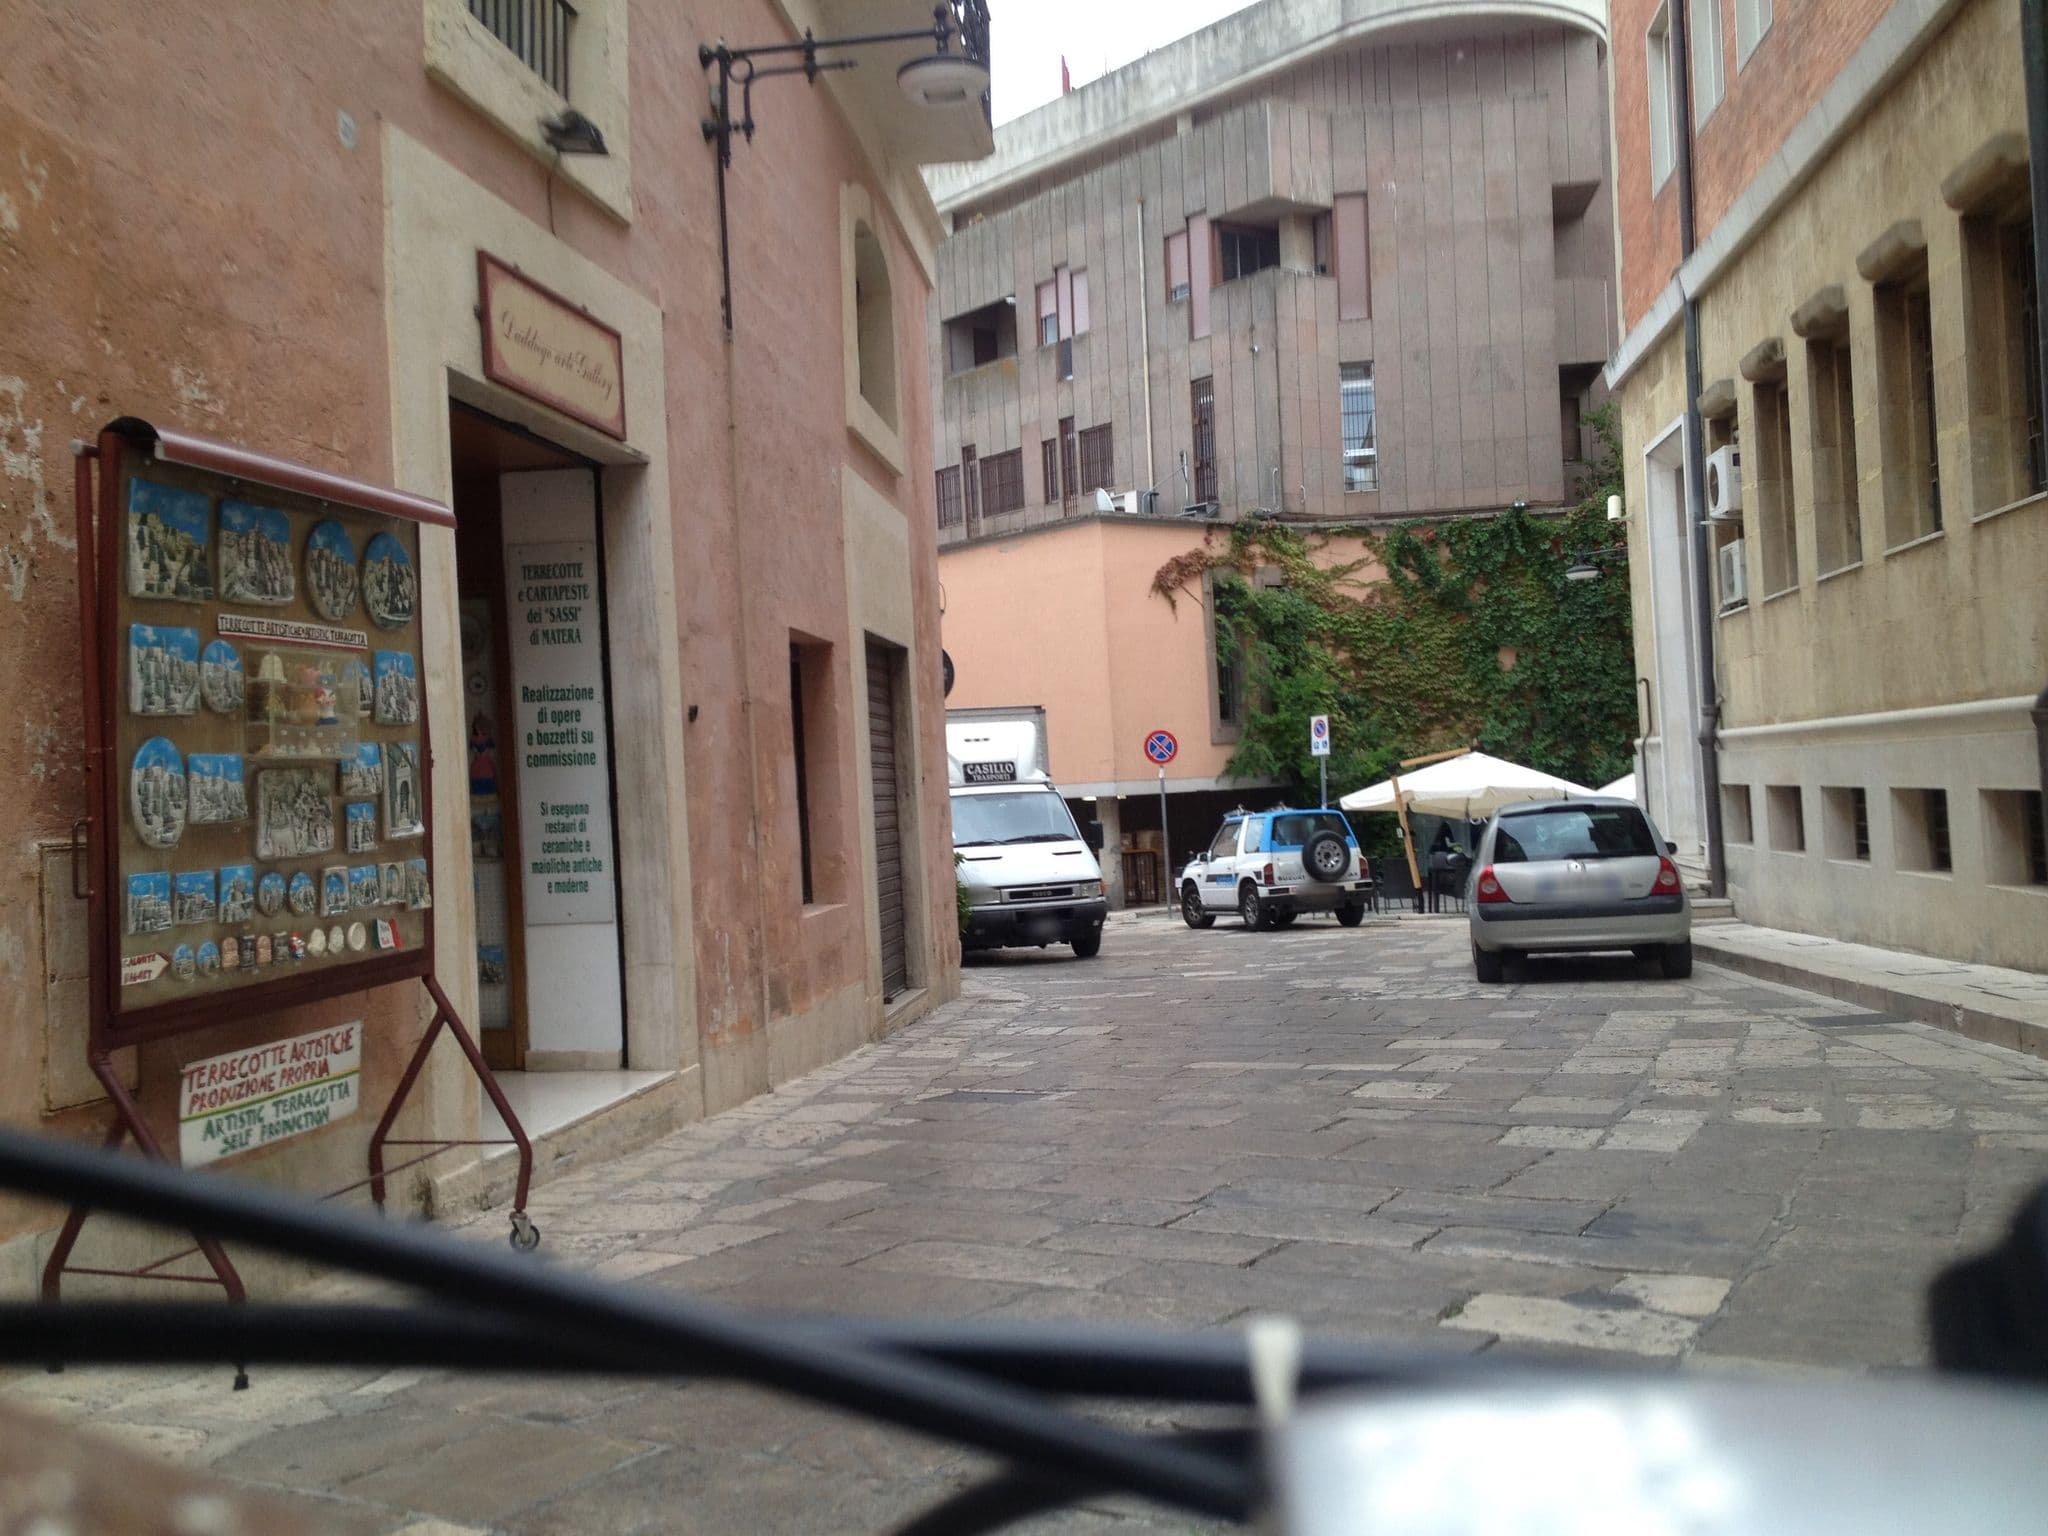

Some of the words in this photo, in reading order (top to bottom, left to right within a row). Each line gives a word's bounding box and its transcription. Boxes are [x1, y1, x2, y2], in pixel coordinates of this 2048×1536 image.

[522, 562, 584, 581] TERRECOTTE
[518, 590, 524, 602] e
[526, 583, 590, 602] CARTAPESTE
[527, 607, 542, 624] dei
[545, 606, 582, 623] "SASSI"
[529, 629, 540, 646] di
[541, 628, 582, 646] MATERA
[522, 684, 594, 703] Realizzazione
[537, 707, 548, 724] di
[550, 708, 582, 727] opere
[526, 732, 534, 746] e
[536, 728, 578, 746] bozzetti
[581, 730, 594, 744] su
[526, 749, 597, 768] commissione
[966, 763, 1015, 775] CASILLO
[540, 801, 549, 816] Si
[550, 803, 589, 818] eseguono
[545, 818, 577, 834] restauri
[578, 818, 587, 833] di
[542, 837, 584, 854] ceramiche
[585, 839, 591, 853] e
[531, 857, 571, 874] maioliche
[573, 856, 602, 873] antiche
[547, 881, 553, 894] e
[554, 877, 589, 894] moderne
[182, 1044, 287, 1093] TERRECOTTE
[188, 1072, 276, 1115] PRODUZIONE
[279, 1059, 330, 1088] PROPRIA
[203, 1106, 265, 1142] ARTISTIC
[272, 1080, 351, 1117] TERRACOTTA
[220, 1128, 253, 1155] SELF
[260, 1106, 330, 1143] PRODUCTION
